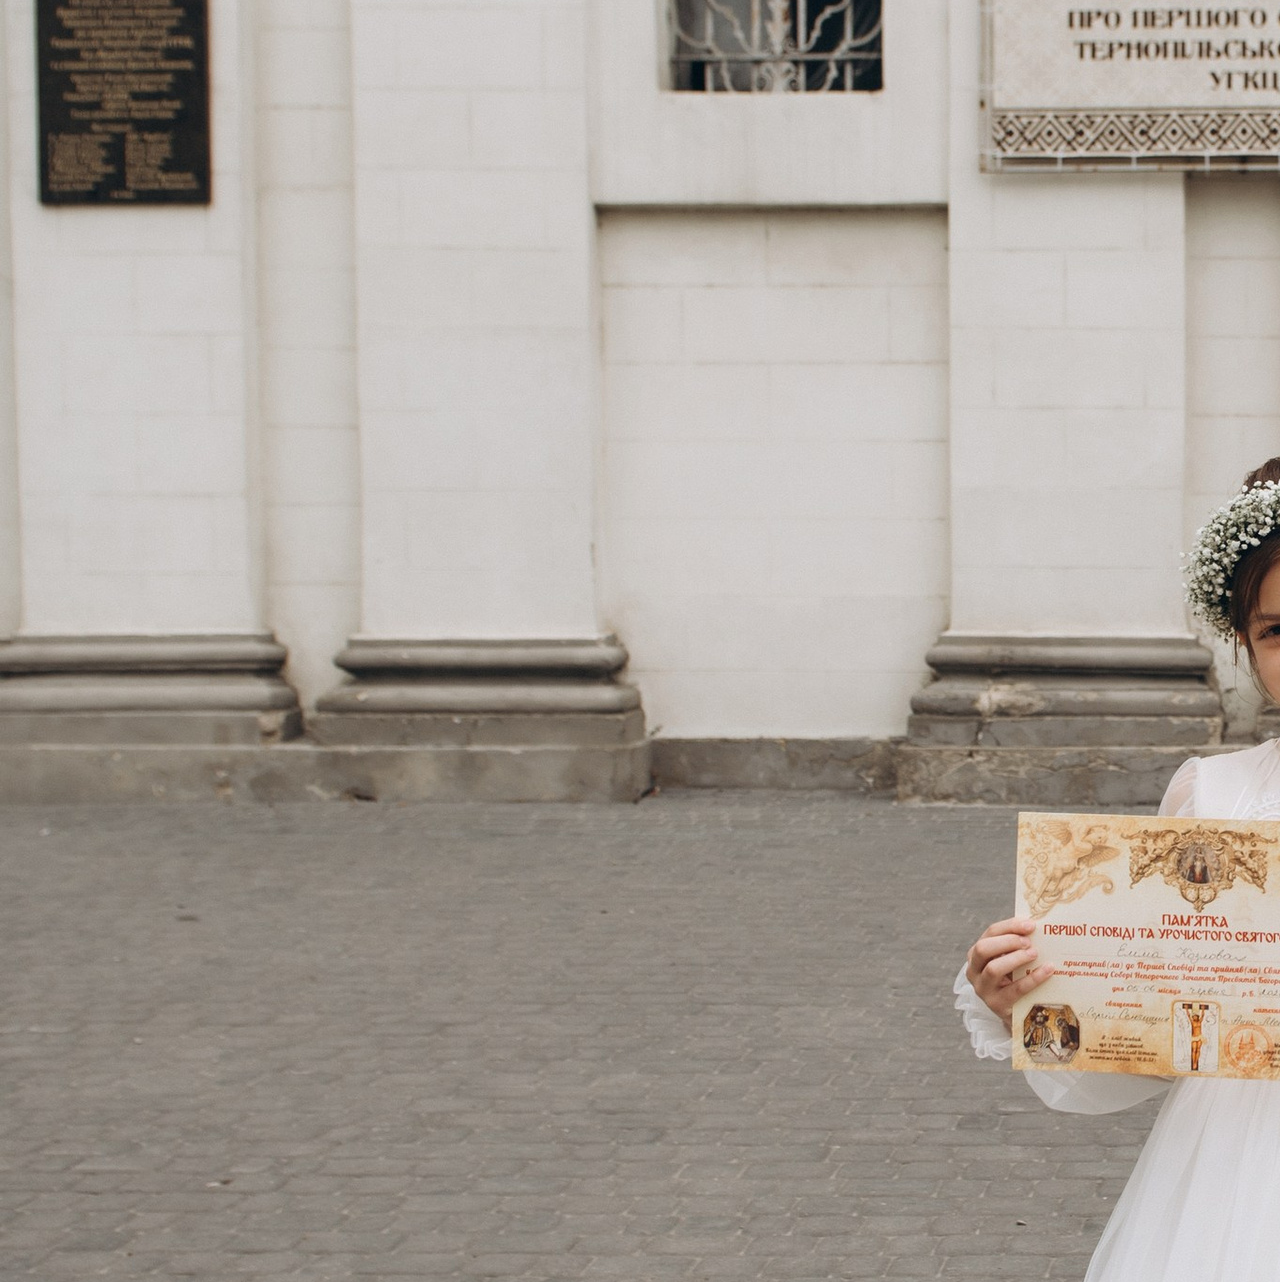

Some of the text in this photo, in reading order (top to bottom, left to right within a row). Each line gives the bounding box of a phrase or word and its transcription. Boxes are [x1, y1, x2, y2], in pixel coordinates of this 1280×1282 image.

[1067, 9, 1121, 31] ПРО
[1131, 7, 1267, 30] ПЕРШОГО
[1209, 69, 1280, 94] УГКЦ
[1162, 914, 1229, 928] ПАМ'ЯТКА
[1043, 924, 1087, 936] ПЕРШОЇ
[1090, 926, 1135, 941] СПОВІДІ
[1138, 928, 1155, 939] ТА
[1158, 928, 1233, 942] УРОЧИСТОГО
